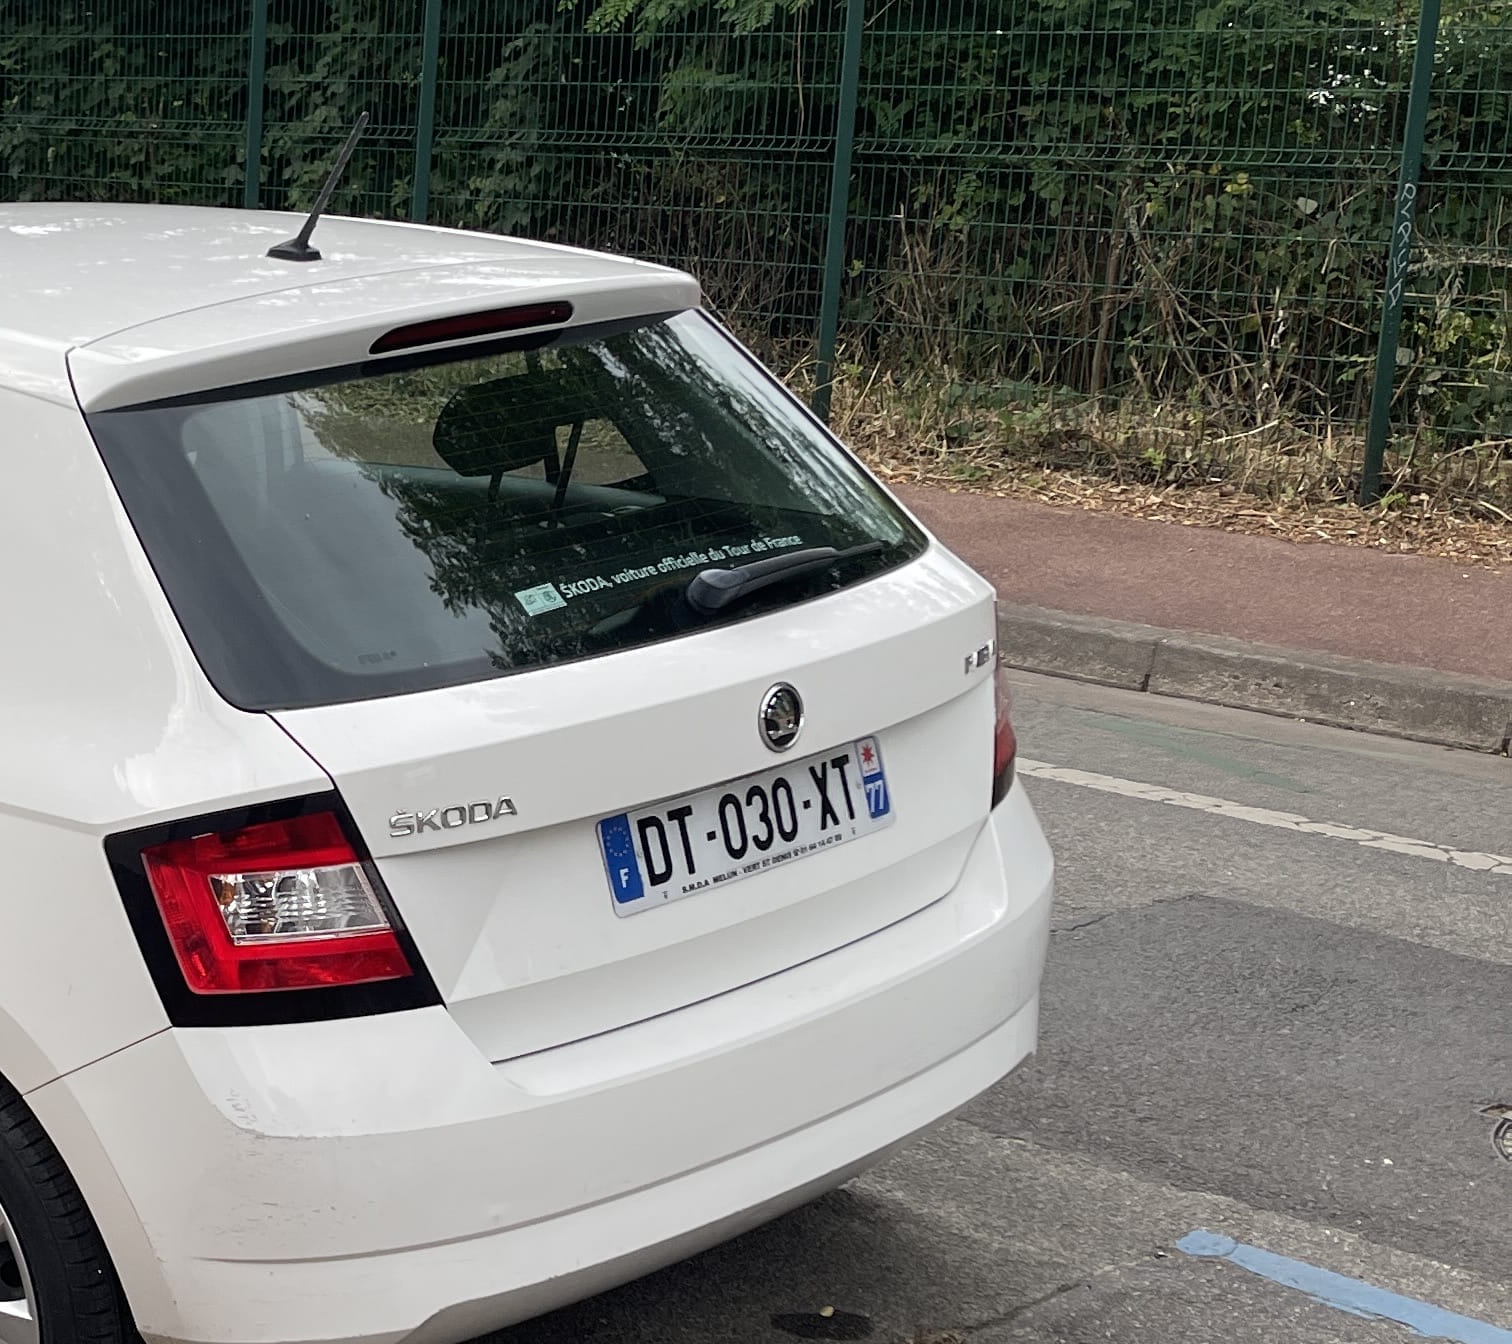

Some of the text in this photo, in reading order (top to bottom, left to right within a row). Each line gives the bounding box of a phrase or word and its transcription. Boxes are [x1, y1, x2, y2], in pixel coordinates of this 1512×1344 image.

[559, 535, 803, 598] ŠKODA, voiture officielle du Tour de France
[865, 779, 884, 813] 77
[389, 795, 518, 838] ŠKODA
[636, 754, 856, 887] DT-030-XT
[619, 867, 629, 889] F
[712, 870, 738, 884] MELUN
